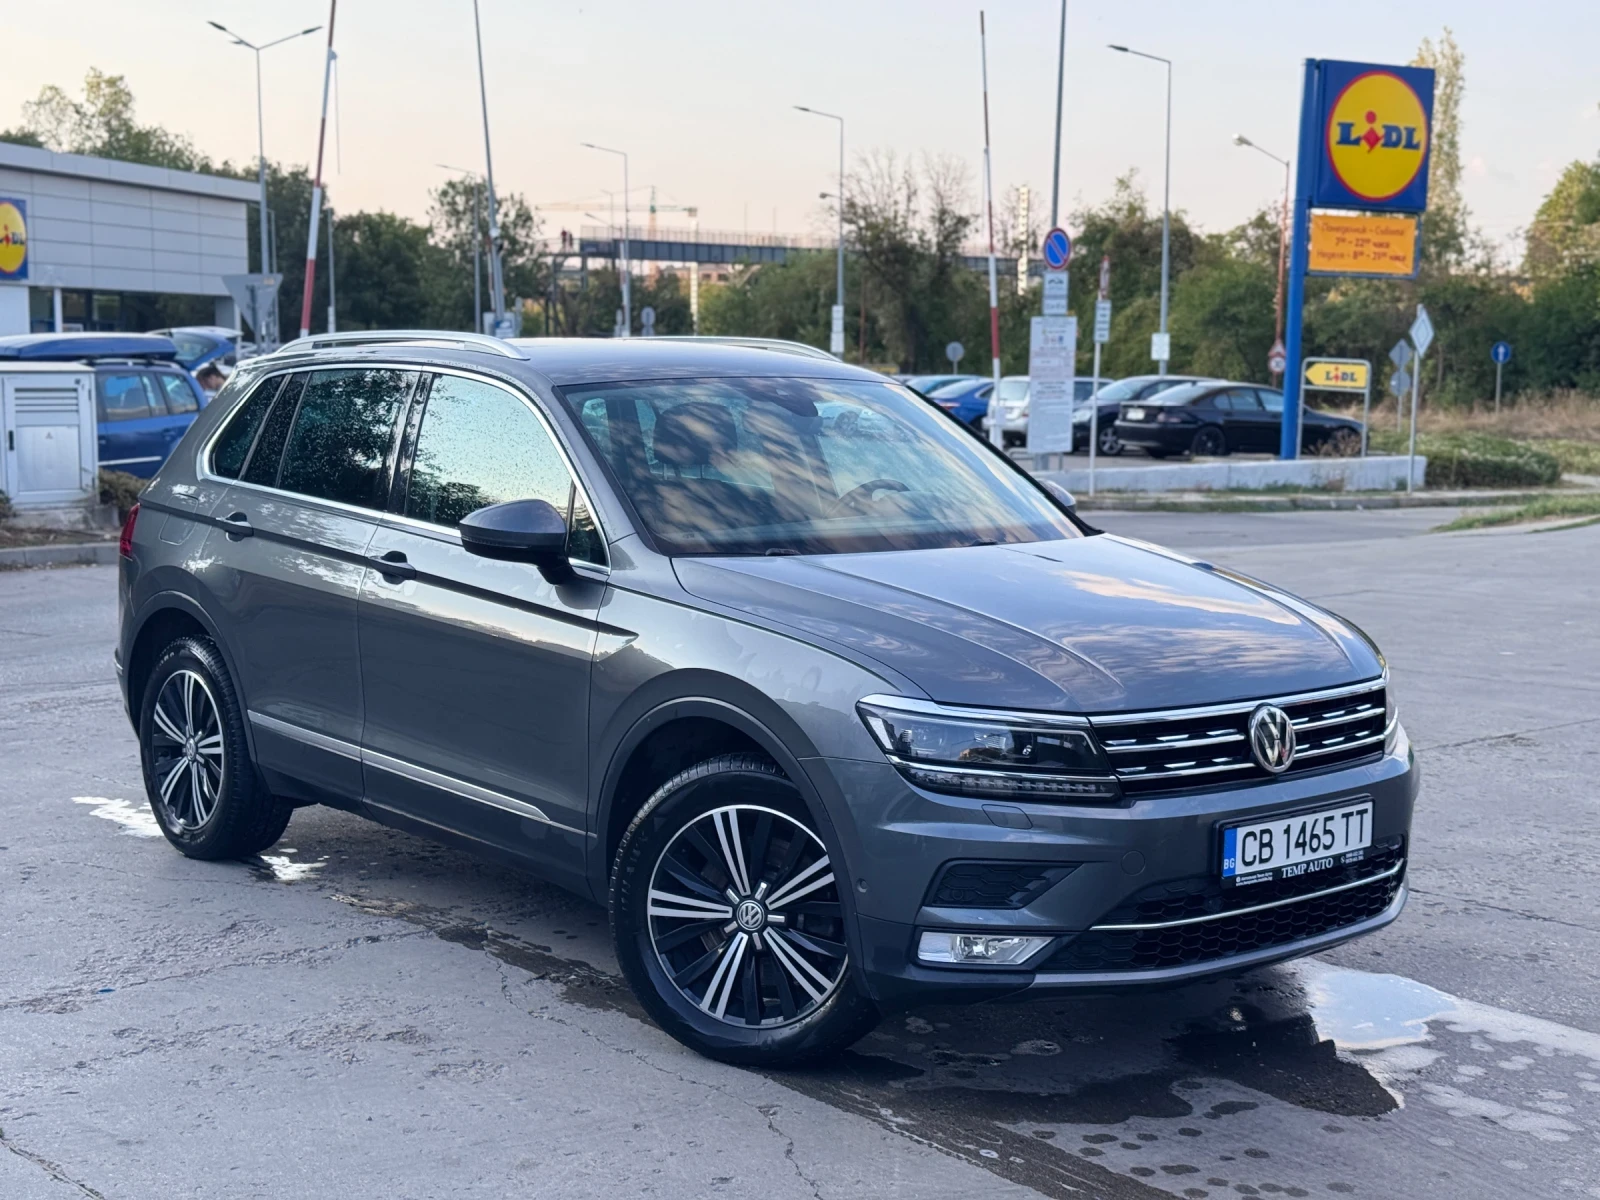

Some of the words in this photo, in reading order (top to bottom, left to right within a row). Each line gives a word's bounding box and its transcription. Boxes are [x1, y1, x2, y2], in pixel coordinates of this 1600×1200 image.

[1242, 828, 1273, 867] CB
[1283, 815, 1335, 860] 1465
[1341, 808, 1368, 846] TT
[1224, 858, 1235, 870] BG
[1281, 862, 1308, 878] TEMP
[1308, 857, 1334, 873] AUTO
